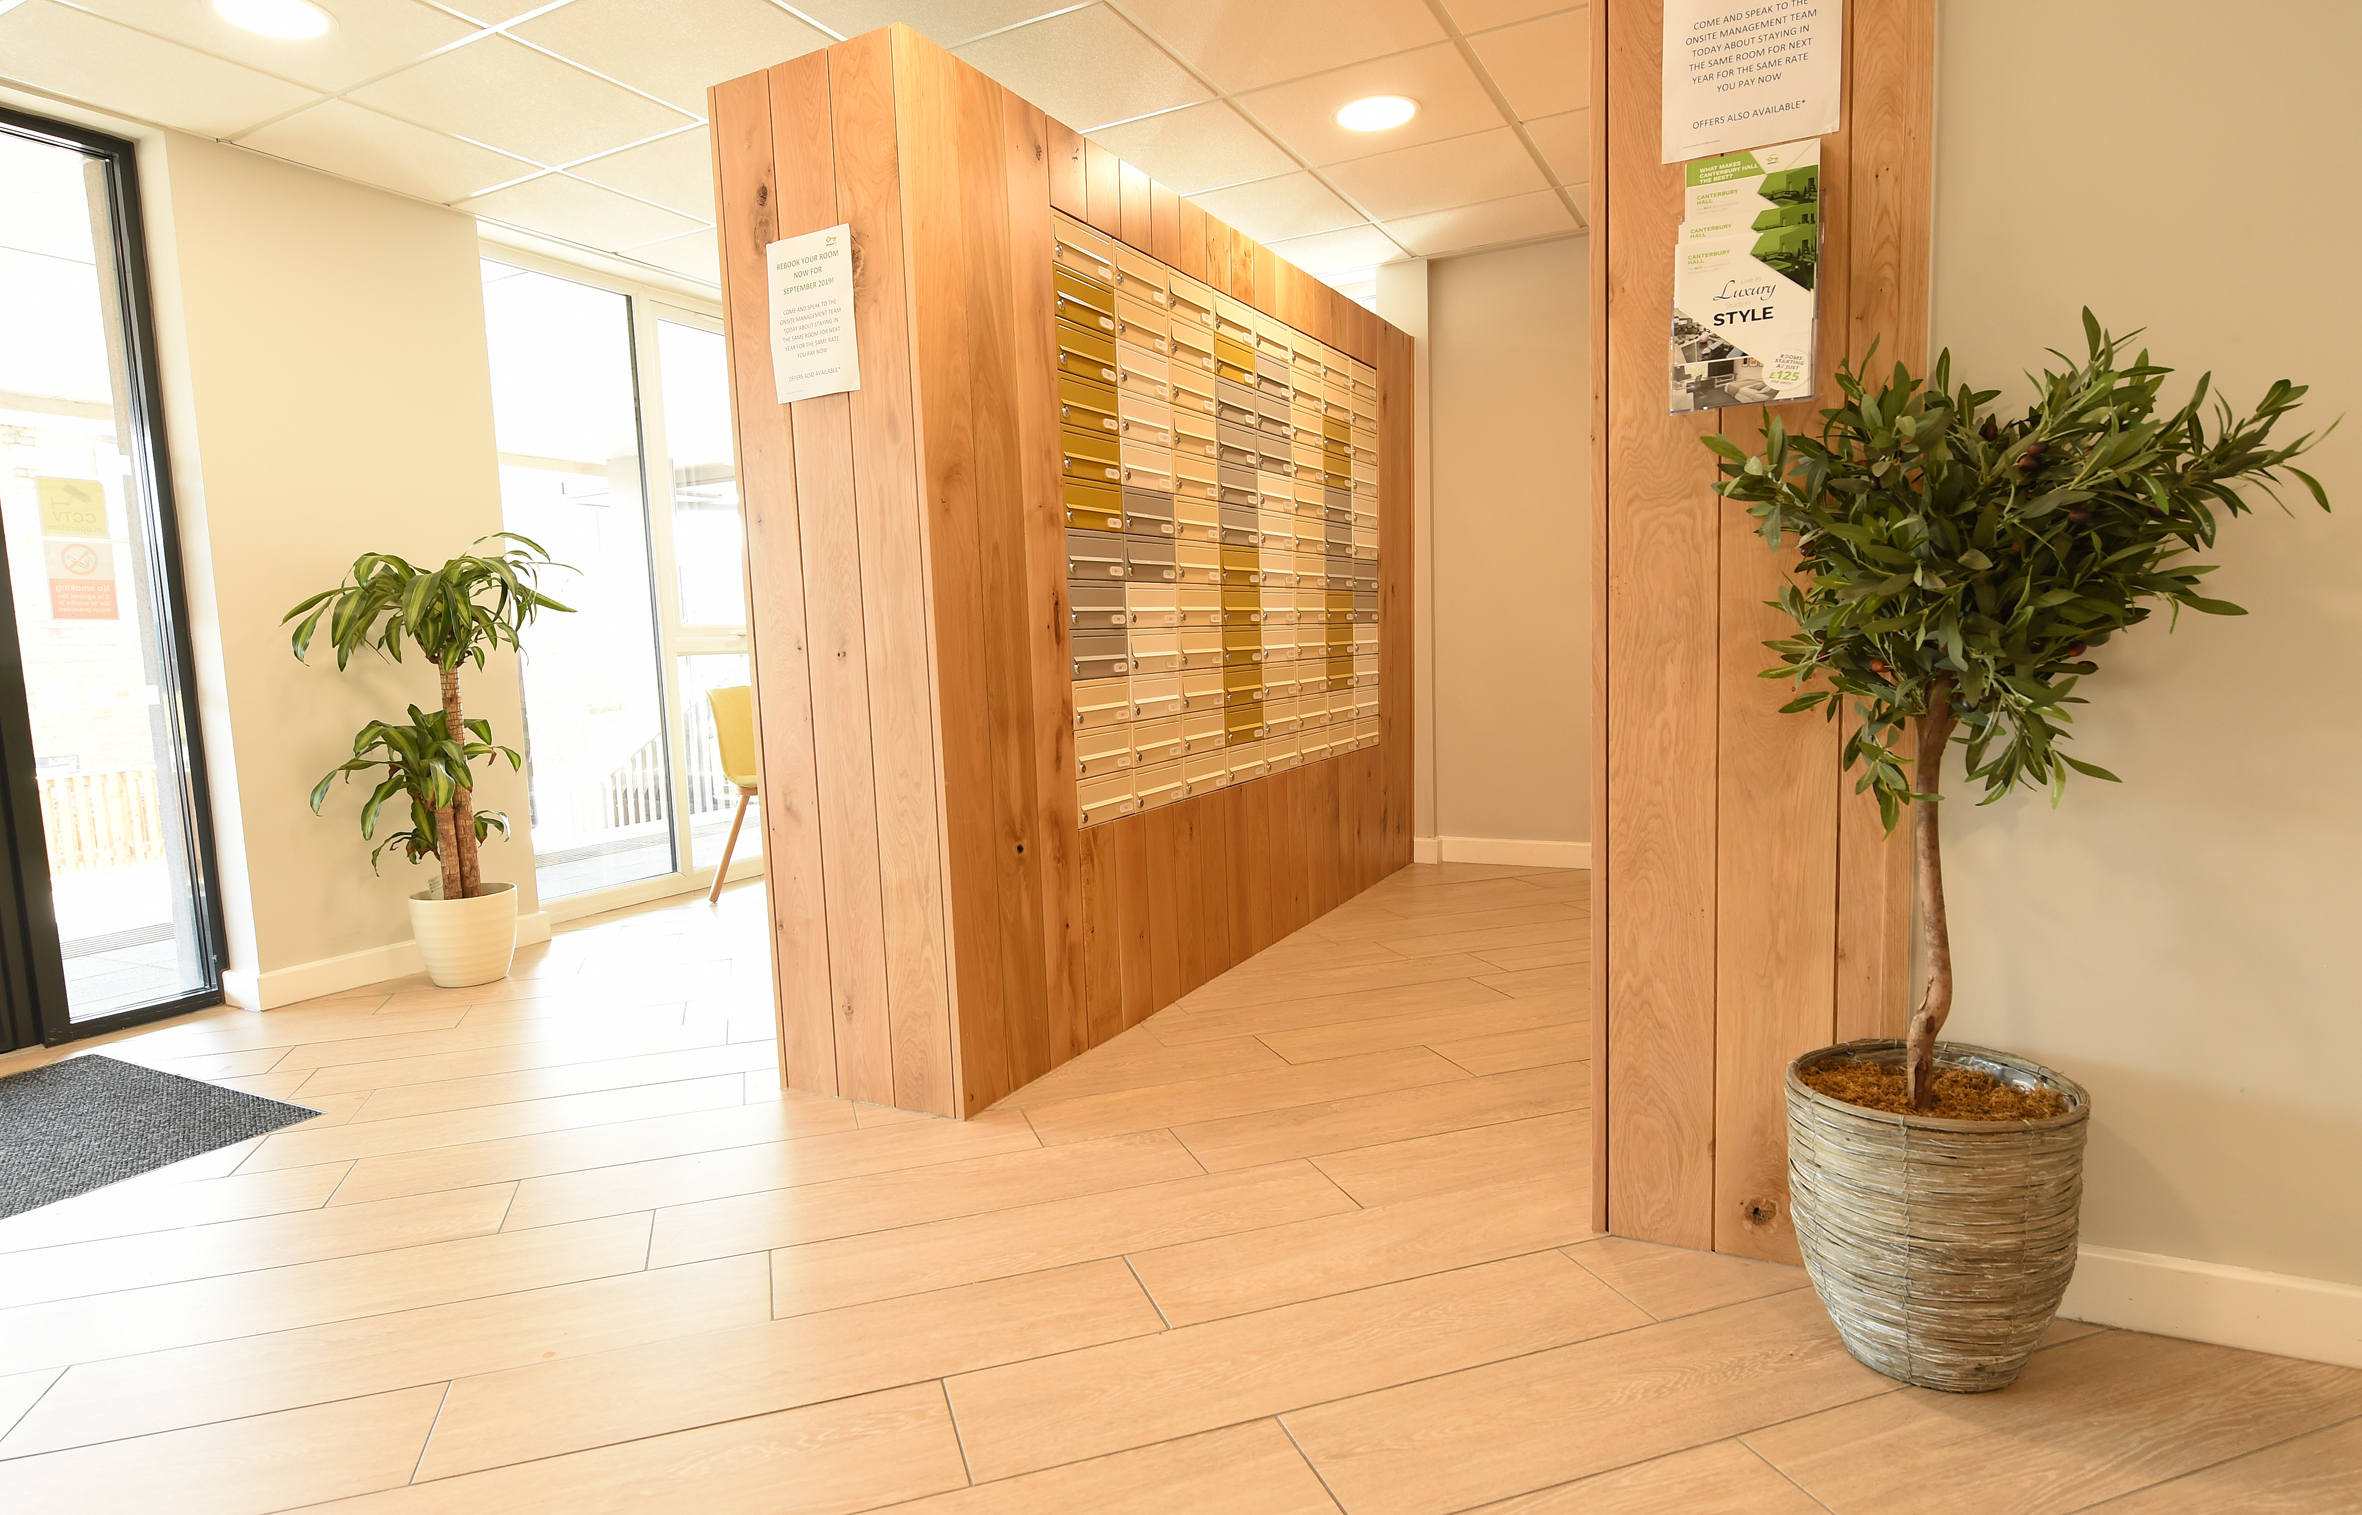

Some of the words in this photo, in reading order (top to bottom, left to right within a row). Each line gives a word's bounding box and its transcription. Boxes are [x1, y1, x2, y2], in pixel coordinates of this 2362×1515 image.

[1693, 17, 1720, 31] COME
[1723, 12, 1743, 24] AND
[1745, 5, 1773, 18] SPEAK
[1776, 1, 1788, 11] TO
[1685, 32, 1717, 46] ONSITE
[1719, 16, 1787, 38] MANAGEMENT
[1790, 8, 1817, 21] TEAM
[1692, 44, 1722, 57] TODAY
[1724, 37, 1756, 50] ABOUT
[1758, 28, 1797, 43] STAYING
[1799, 24, 1810, 33] IN
[1689, 61, 1706, 72] THE
[1708, 55, 1733, 67] SAME
[1735, 49, 1765, 62] ROOM
[1768, 43, 1786, 54] FOR
[1788, 37, 1813, 50] NEXT
[1692, 73, 1714, 85] YEAR
[1716, 68, 1734, 79] FOR
[1736, 64, 1754, 75] THE
[1756, 58, 1782, 70] SAME
[1785, 52, 1809, 65] RATE
[1716, 81, 1736, 93] YOU
[1738, 78, 1755, 88] PAY
[1758, 72, 1782, 84] NOW
[1692, 115, 1724, 129] OFFERS
[1727, 111, 1750, 123] ALSO
[1699, 163, 1717, 173] WHAT
[1719, 160, 1741, 170] MAKES
[1699, 167, 1741, 179] CANTERBURY
[1742, 163, 1759, 171] HALL
[1697, 189, 1739, 200] CANTERBURY
[1690, 223, 1732, 234] CANTERBURY
[776, 259, 800, 271] REBOOK
[801, 255, 818, 264] YOUR
[819, 249, 839, 259] ROOM
[1687, 249, 1731, 260] CANTERBURY
[793, 270, 809, 279] NOW
[810, 266, 822, 275] FOR
[783, 281, 817, 295] SEPTEMBER
[1713, 280, 1776, 301] Luxury
[780, 317, 794, 325] ONSITE
[795, 310, 827, 322] MANAGEMENT
[1713, 306, 1774, 326] STYLE
[799, 322, 813, 330] ABOUT
[814, 319, 832, 327] STAYING
[789, 374, 803, 382] OFFERS
[1769, 370, 1800, 381] £125
